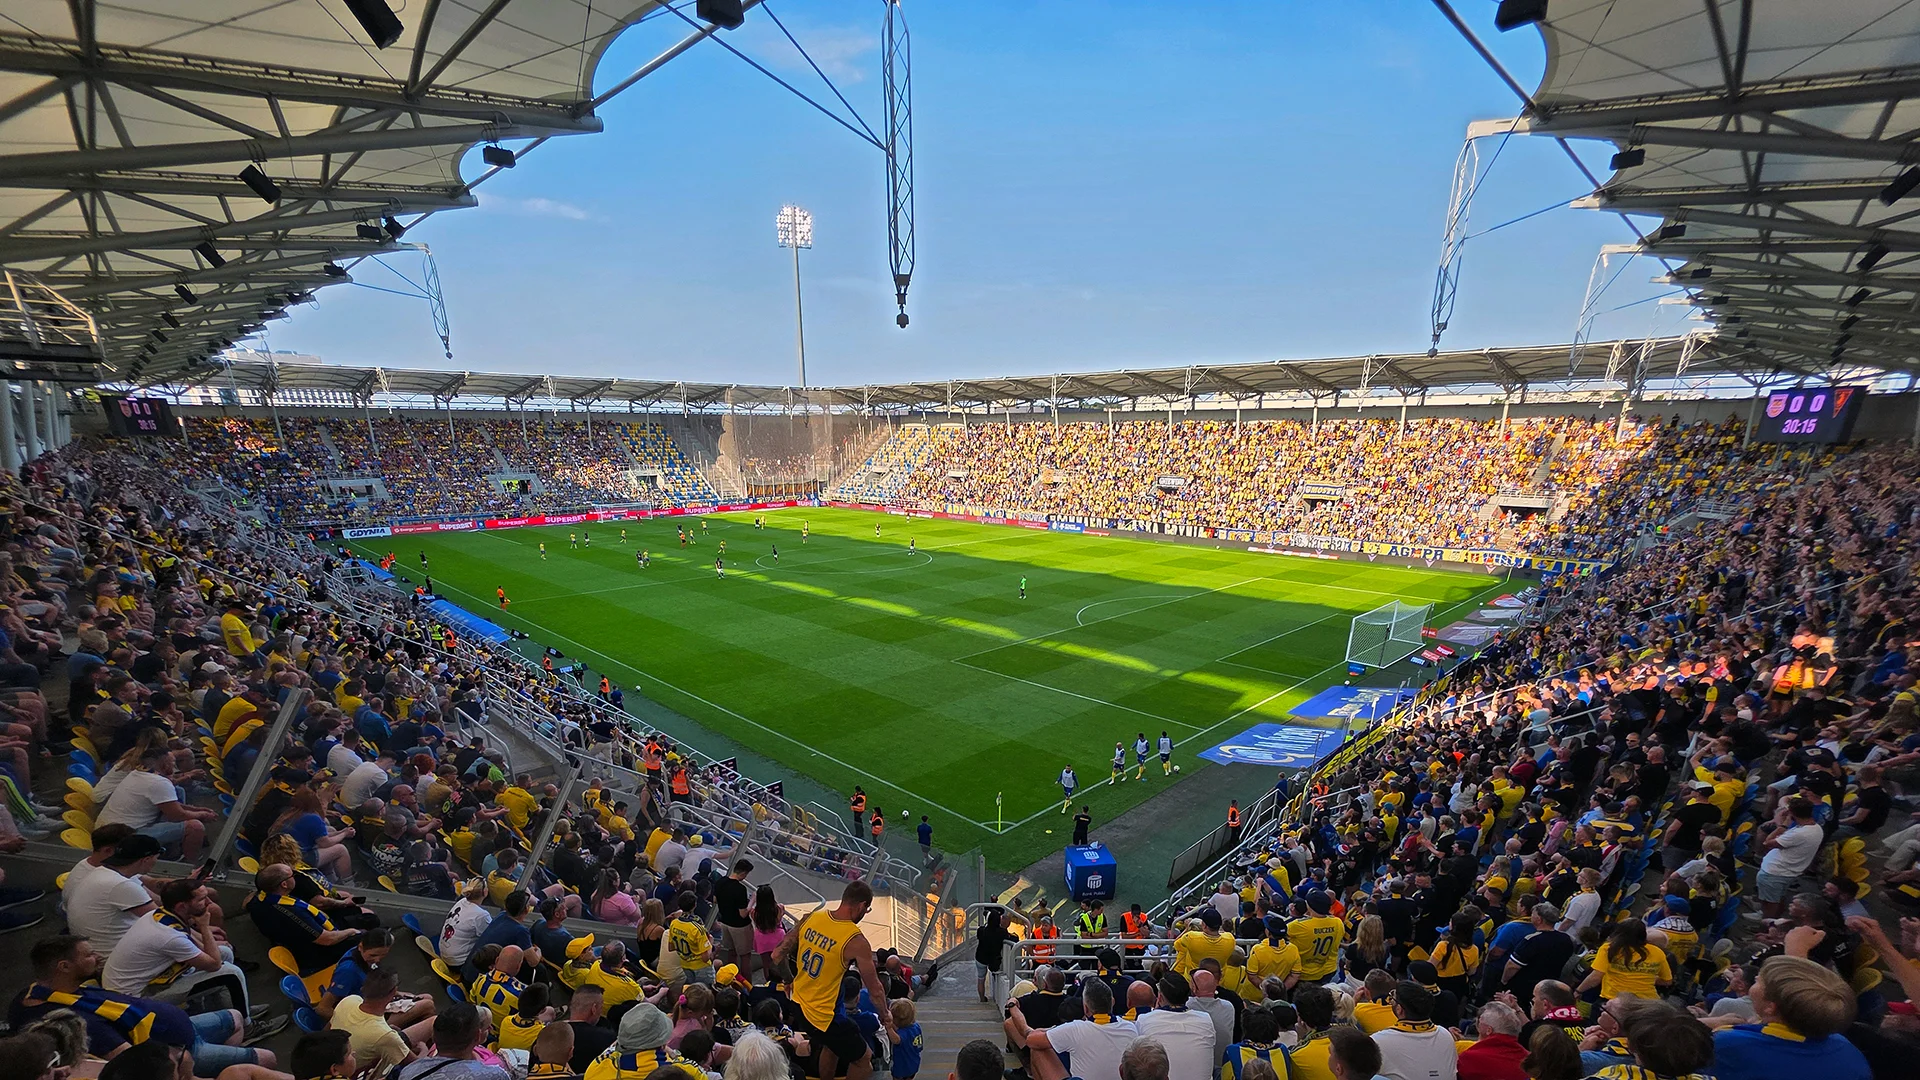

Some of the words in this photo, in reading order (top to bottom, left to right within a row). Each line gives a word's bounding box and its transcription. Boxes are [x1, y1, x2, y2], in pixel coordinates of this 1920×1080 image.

[132, 402, 141, 415] 0
[143, 402, 152, 415] 0
[1789, 395, 1805, 413] 0
[1809, 394, 1826, 412] 0
[1781, 418, 1818, 433] 30:15
[684, 506, 719, 514] SUPERBET
[438, 521, 473, 531] SUPERBET
[545, 513, 587, 524] SUPERBET
[349, 528, 386, 538] GDYNIA
[672, 935, 692, 956] 10
[804, 927, 837, 953] OSTRY
[1312, 935, 1334, 956] 10
[801, 946, 825, 980] 40
